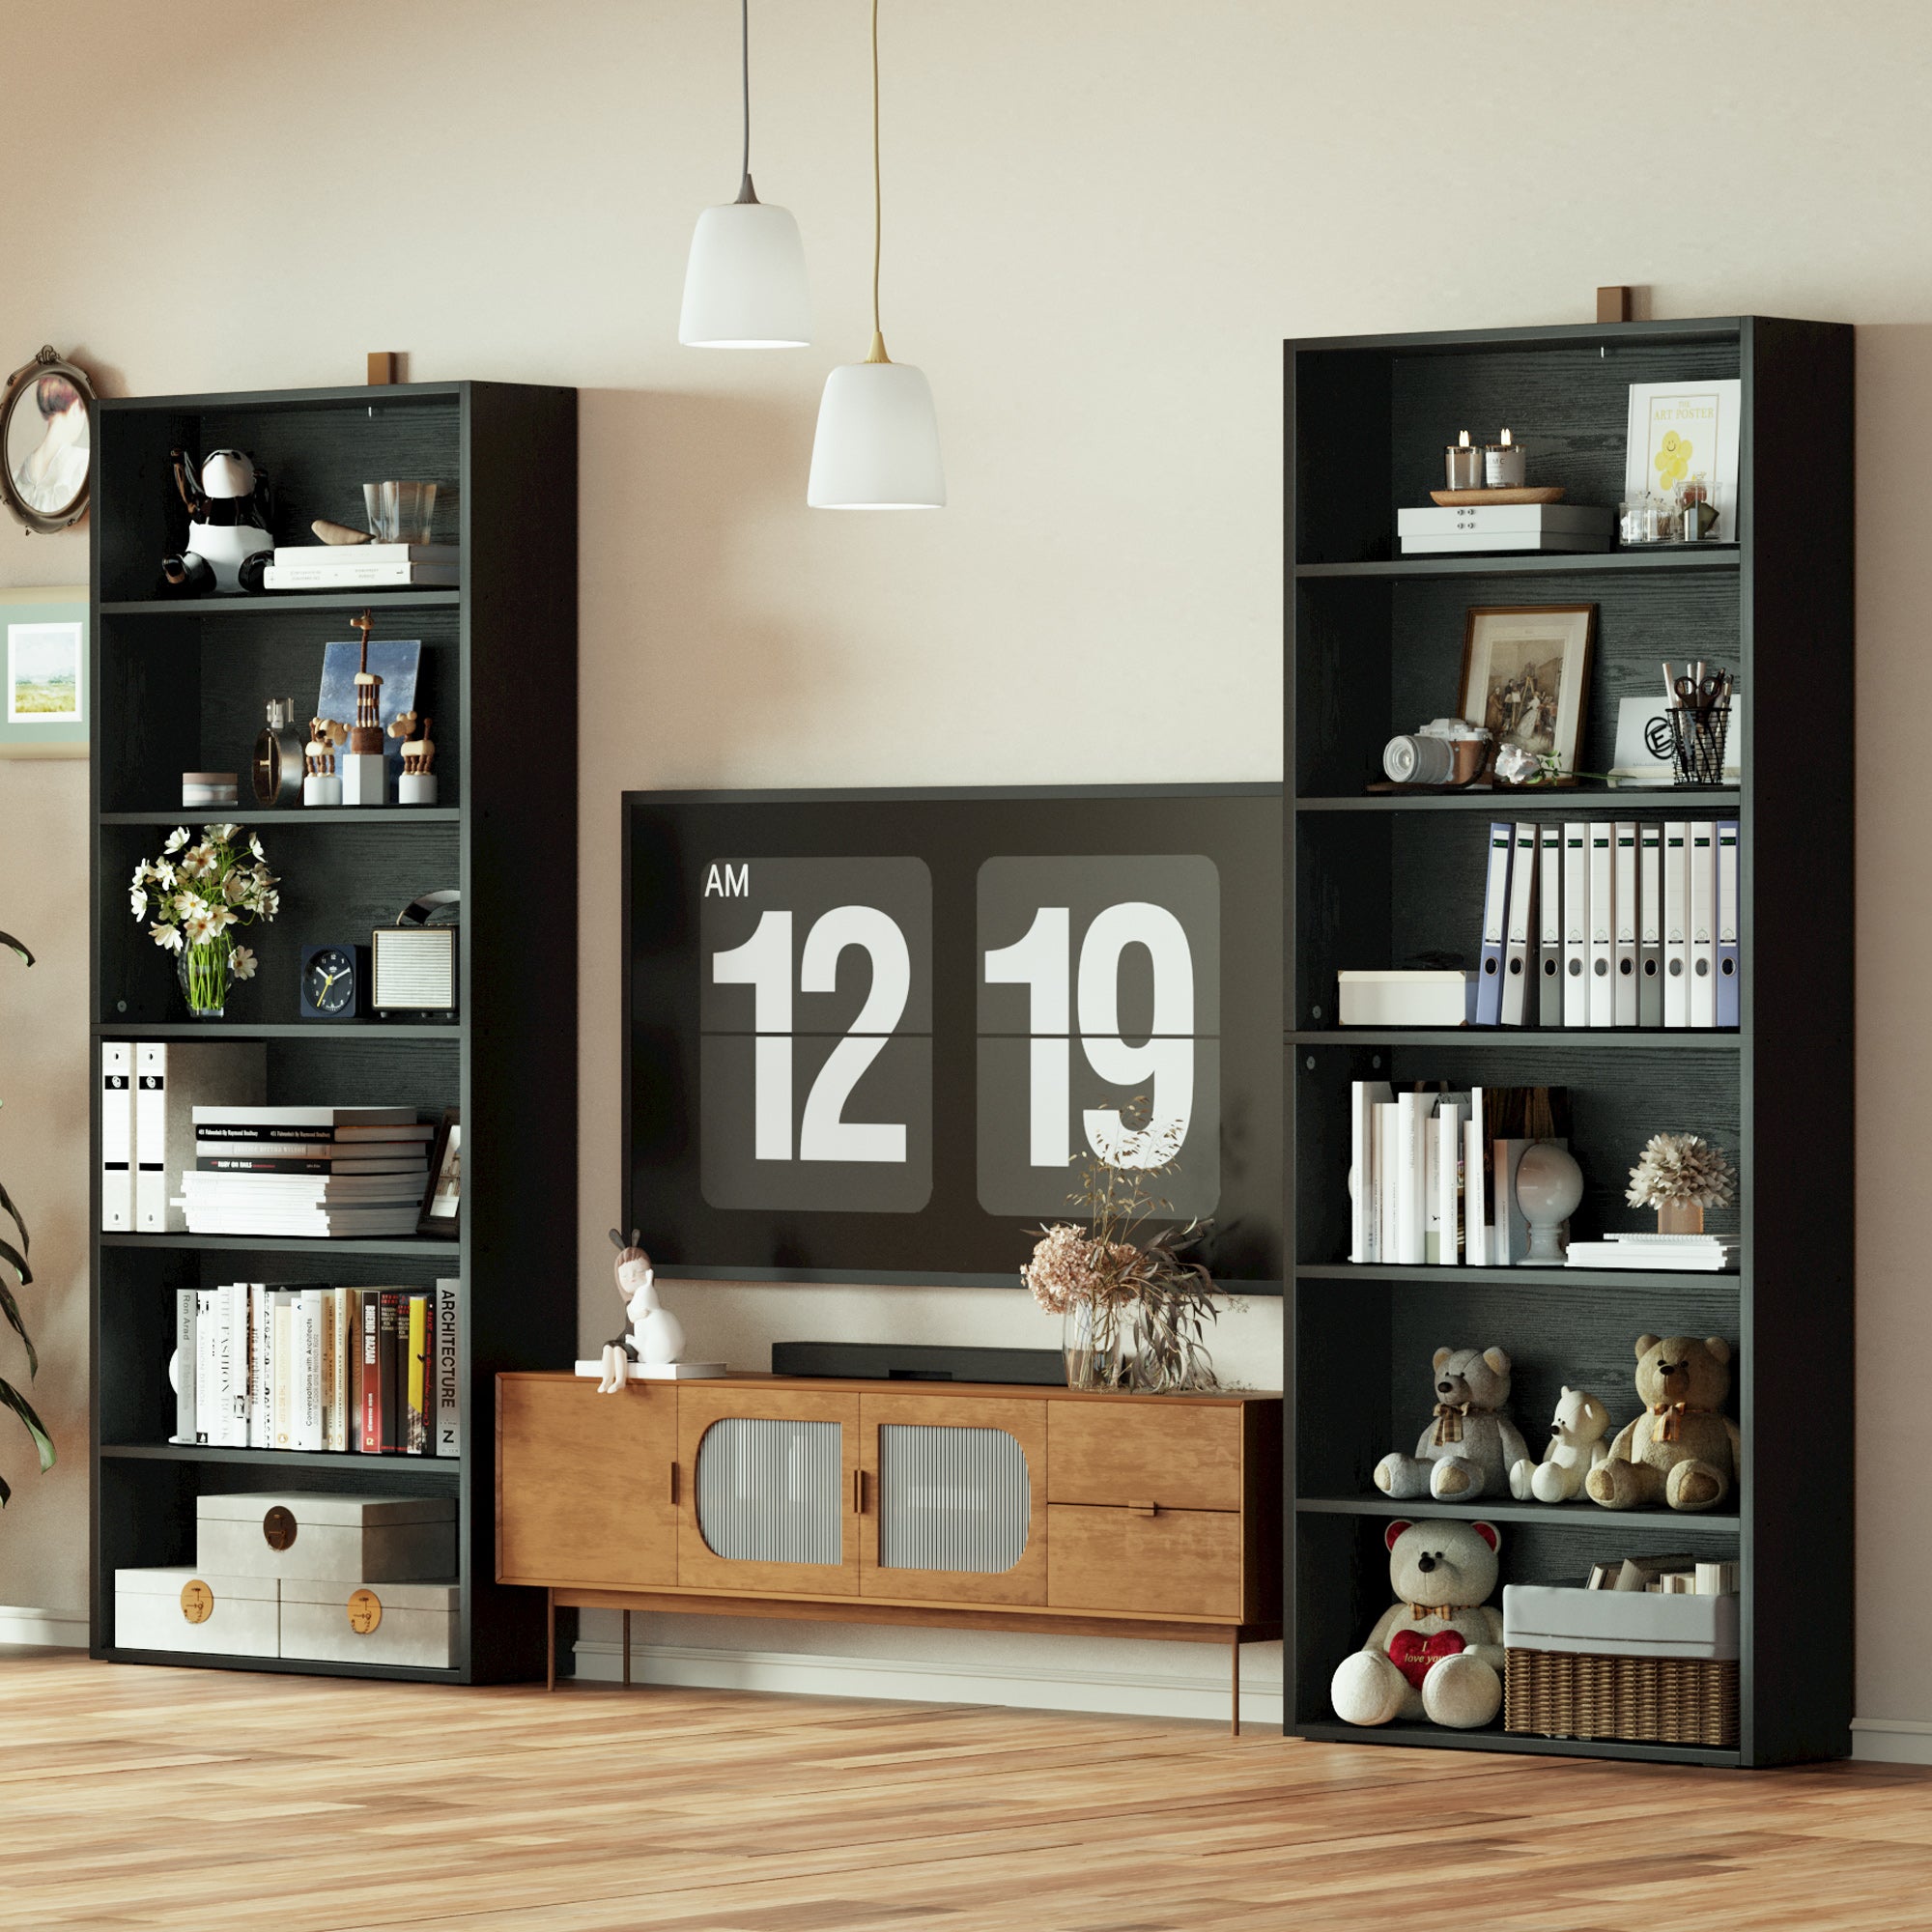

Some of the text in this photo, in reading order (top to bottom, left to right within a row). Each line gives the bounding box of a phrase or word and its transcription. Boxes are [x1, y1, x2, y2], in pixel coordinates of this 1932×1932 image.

[1654, 408, 1715, 420] ART POSTER
[703, 864, 750, 898] AM
[713, 901, 1194, 1170] 12 19
[183, 1294, 191, 1315] Ron
[183, 1318, 191, 1341] Arad
[365, 1305, 376, 1334] BHENDI
[365, 1335, 376, 1365] BAZAAR
[440, 1290, 456, 1408] ARCHITECTURE
[220, 1290, 230, 1440] THE FASHION BOOK
[1404, 1653, 1425, 1662] love
[1421, 1640, 1428, 1653] I
